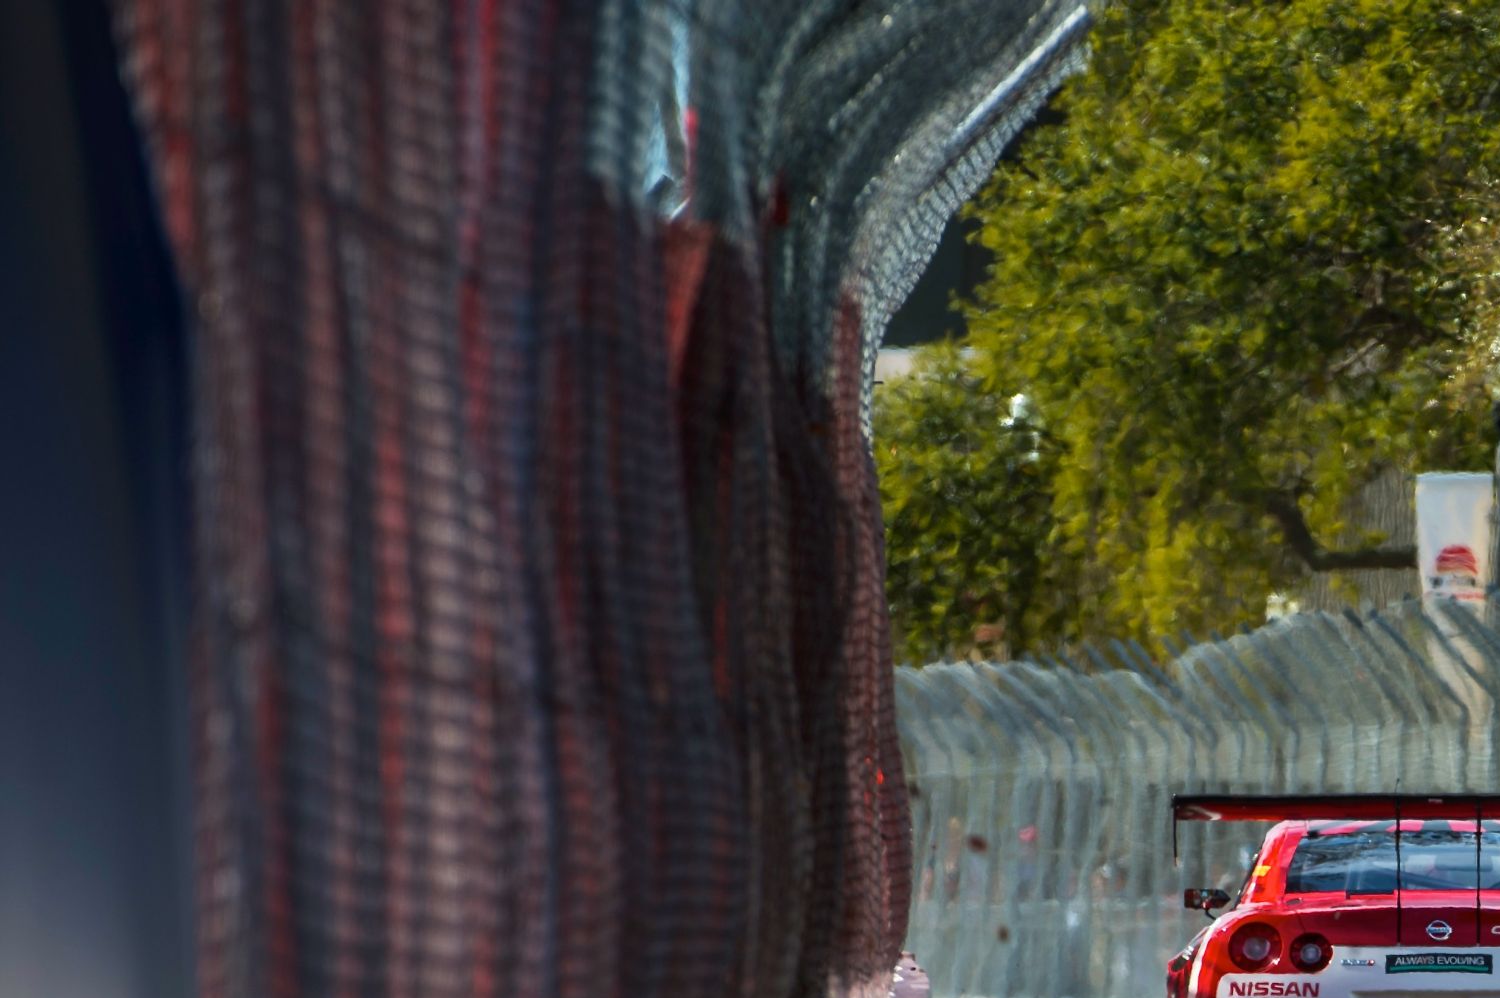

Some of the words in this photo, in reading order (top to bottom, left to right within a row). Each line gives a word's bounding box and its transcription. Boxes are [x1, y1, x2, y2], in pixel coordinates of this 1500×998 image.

[1395, 956, 1434, 966] ALWAYS
[1437, 956, 1485, 966] EVOLVING
[1229, 981, 1320, 997] NISSAN
